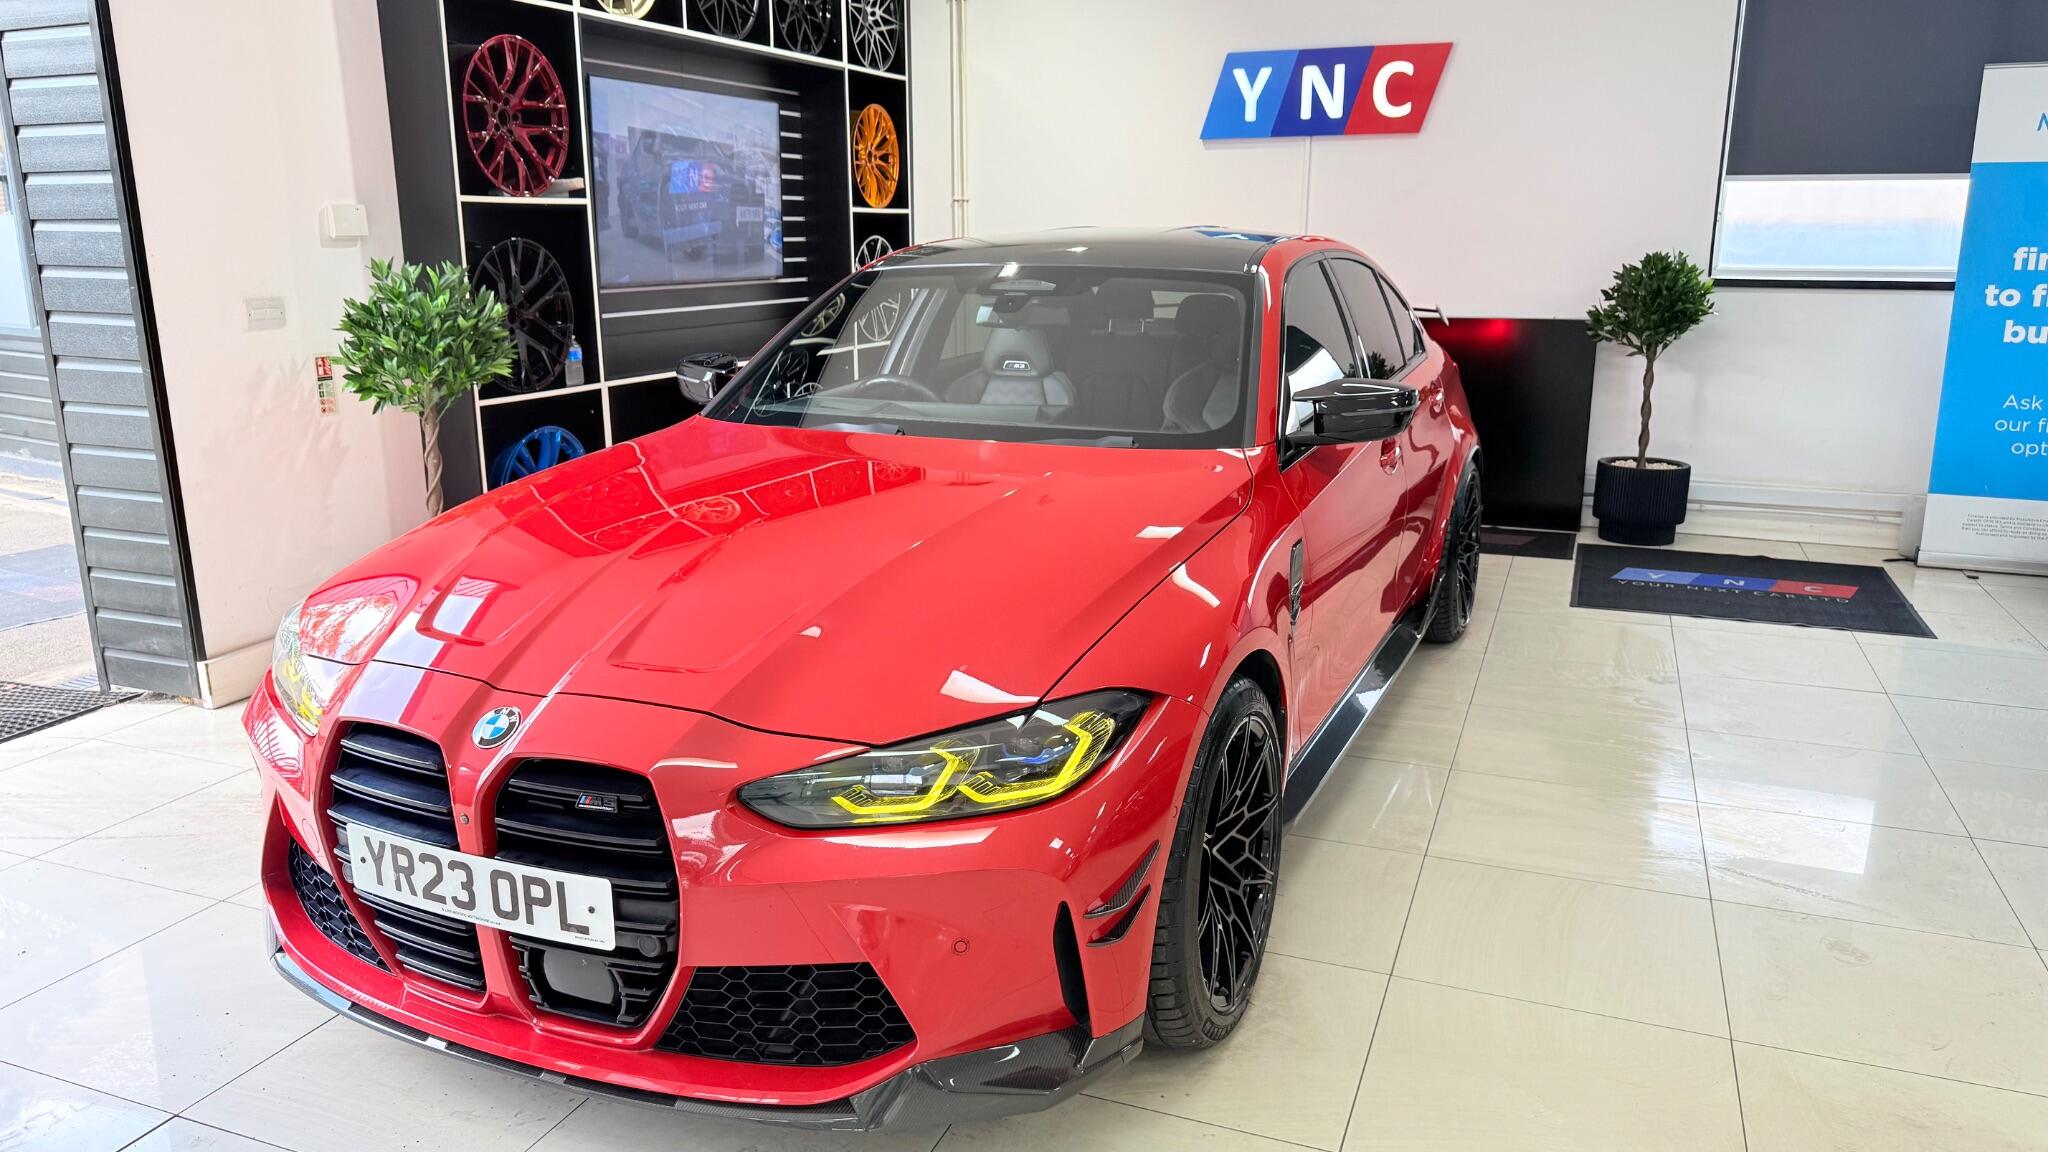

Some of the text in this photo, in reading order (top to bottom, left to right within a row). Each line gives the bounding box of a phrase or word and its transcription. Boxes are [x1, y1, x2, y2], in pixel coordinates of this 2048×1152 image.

[1232, 60, 1415, 122] YNC
[1984, 284, 2021, 307] to
[2002, 394, 2043, 410] Ask
[1994, 419, 2031, 432] our
[1617, 580, 1675, 589] YOUR
[1686, 585, 1741, 595] NEXT
[1753, 591, 1796, 599] CAR
[364, 835, 590, 935] YR23 OPL
